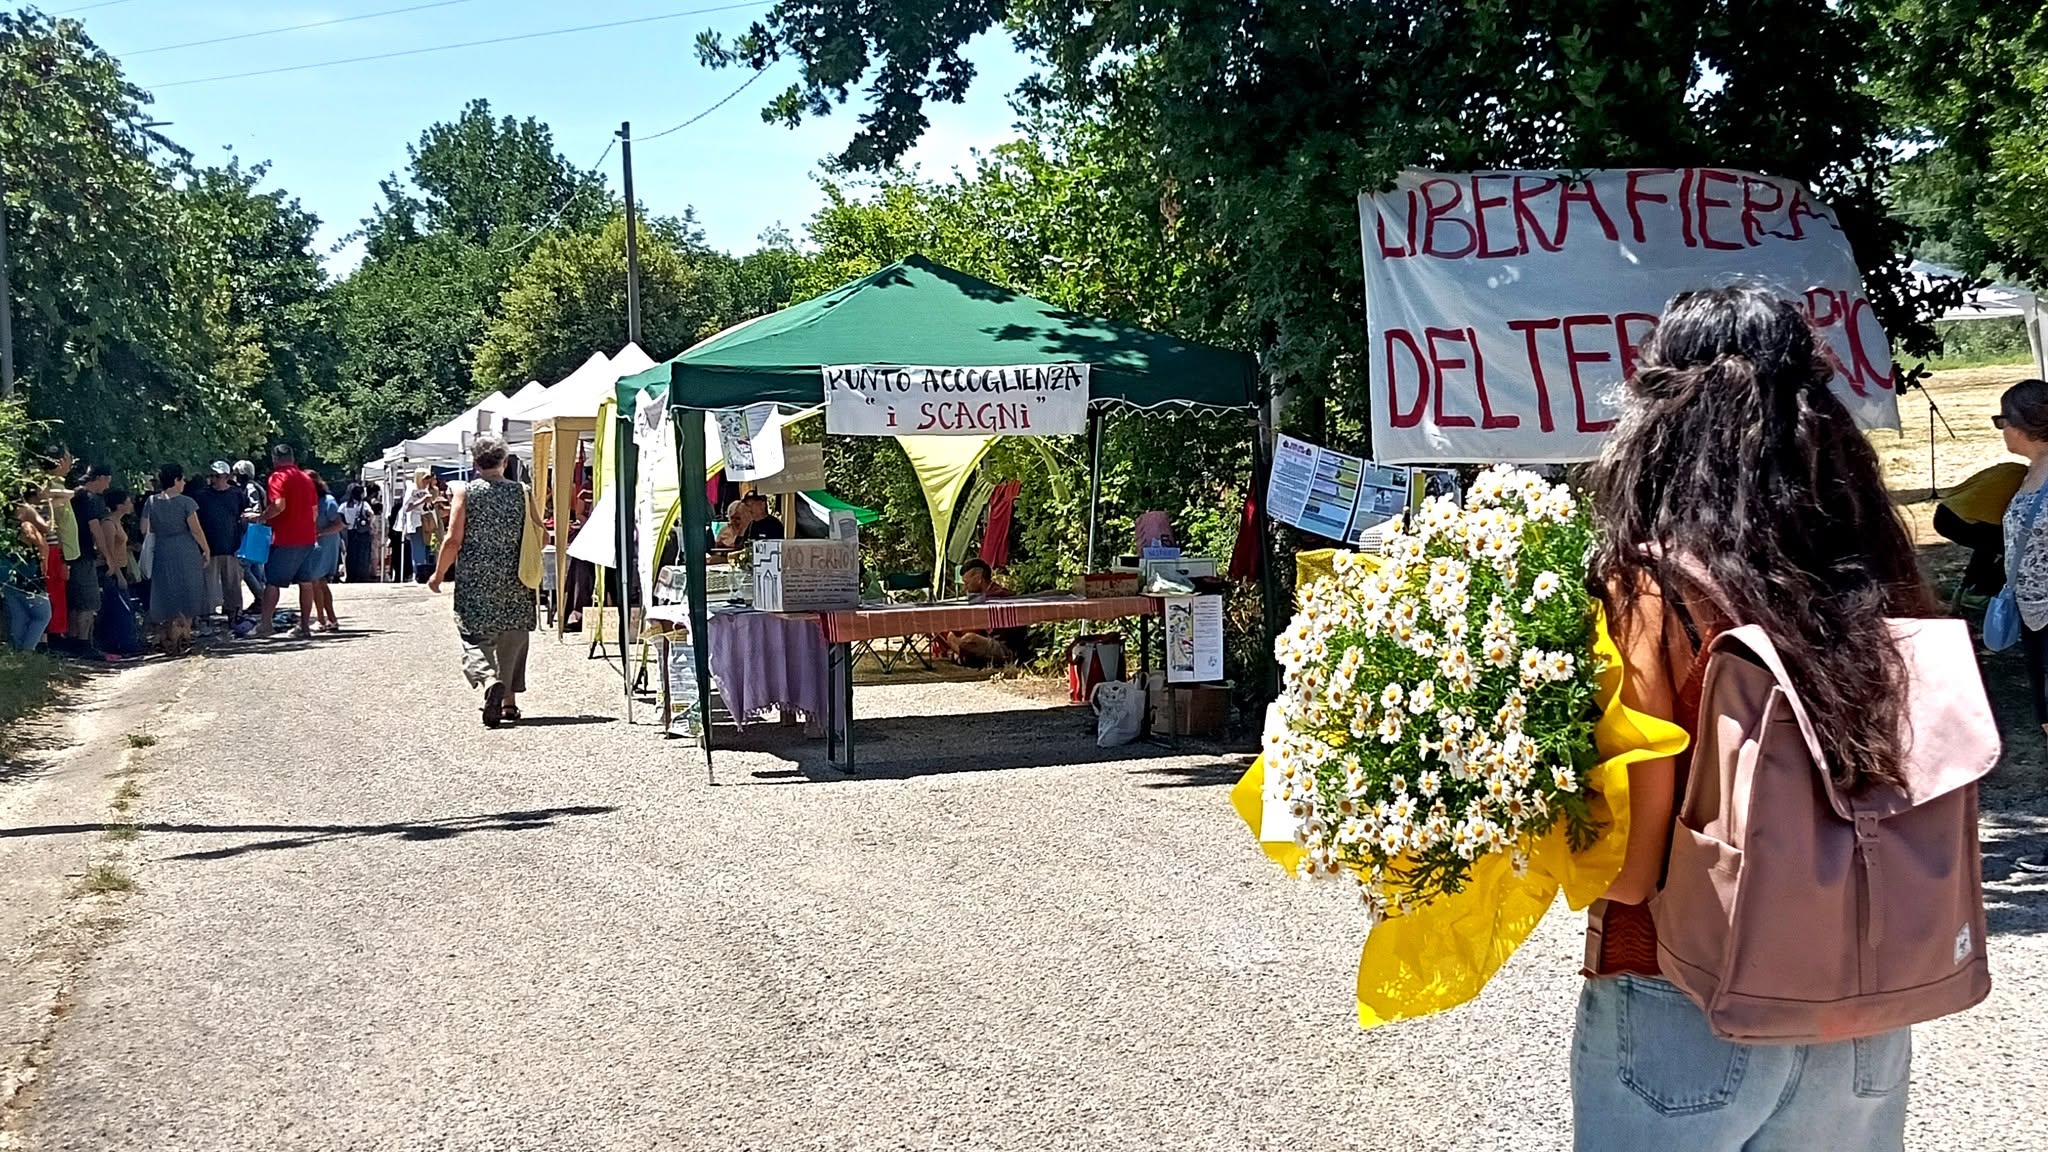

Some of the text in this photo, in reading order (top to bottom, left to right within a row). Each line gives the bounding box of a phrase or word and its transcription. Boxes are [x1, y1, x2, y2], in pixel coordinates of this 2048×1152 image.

[1374, 168, 1841, 259] LIBERA FIERA
[828, 365, 1083, 394] PUNTO ACCOGLIENZA
[1384, 326, 1520, 430] DEL
